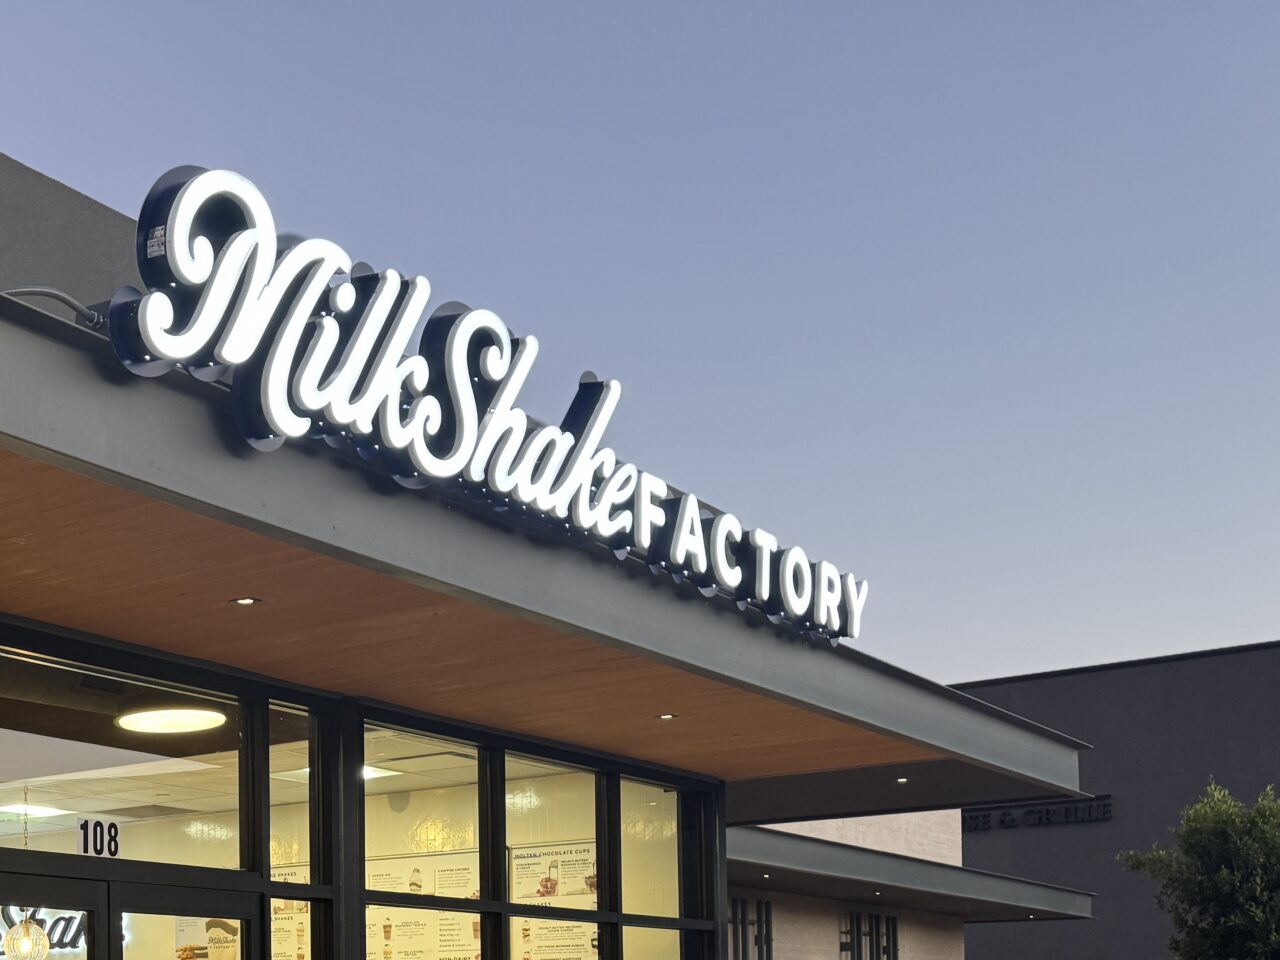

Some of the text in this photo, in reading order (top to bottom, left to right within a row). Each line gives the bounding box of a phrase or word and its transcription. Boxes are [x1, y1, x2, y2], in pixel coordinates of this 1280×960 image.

[632, 471, 868, 638] FACTORY
[80, 819, 119, 857] 108
[539, 849, 573, 858] CHOCOLATE
